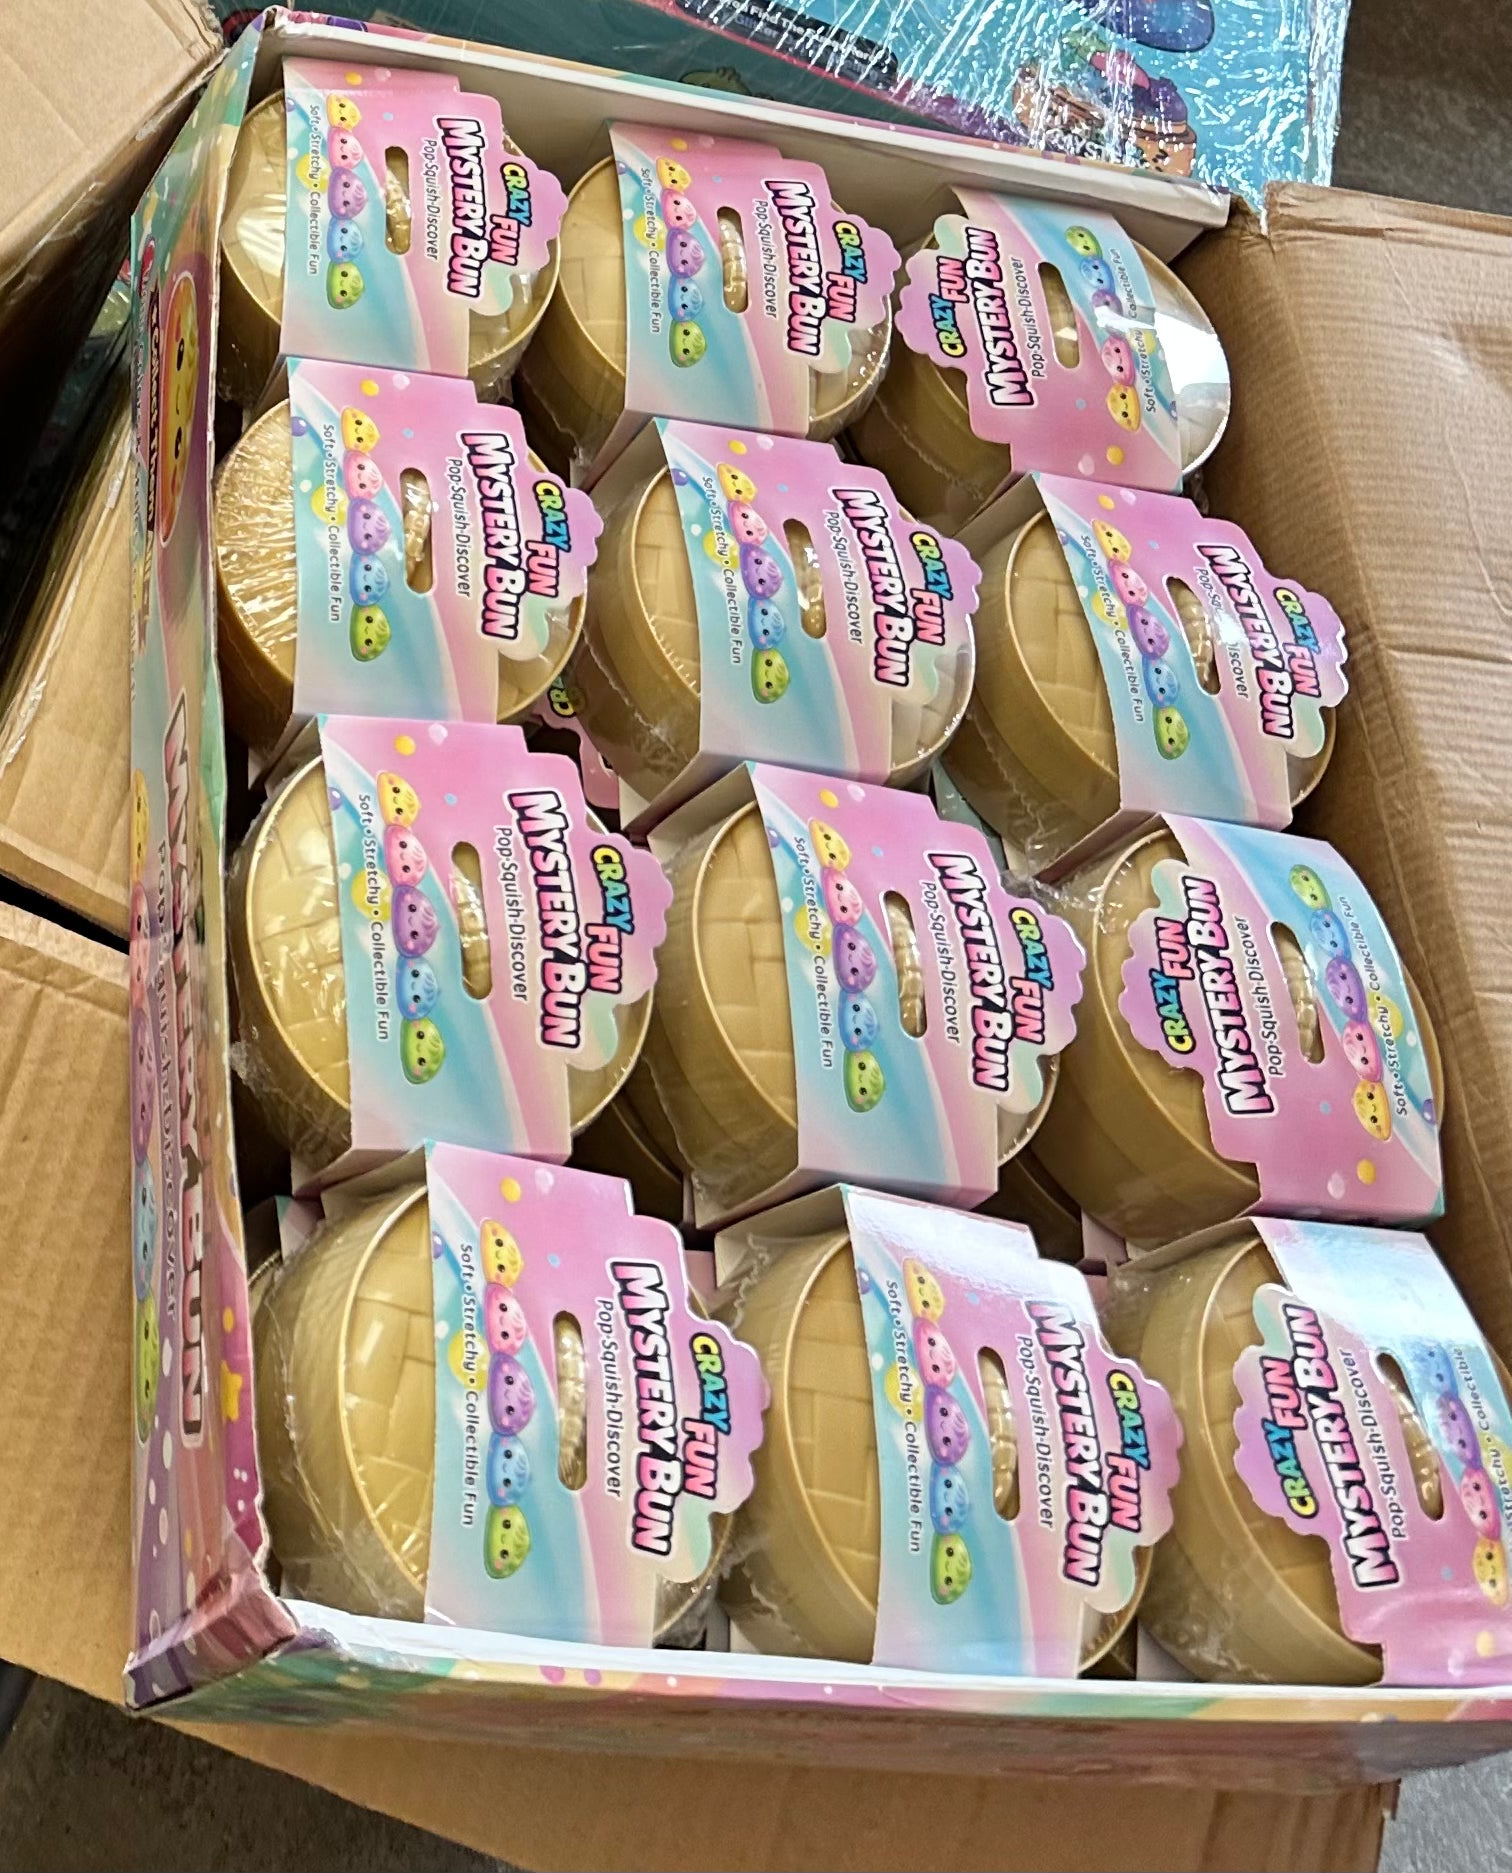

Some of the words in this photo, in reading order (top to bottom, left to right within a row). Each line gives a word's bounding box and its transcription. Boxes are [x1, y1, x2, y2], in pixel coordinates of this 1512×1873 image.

[310, 105, 319, 125] Soft
[310, 134, 321, 180] Stretchy
[438, 117, 486, 241] MYSTERY
[310, 192, 320, 249] Collectible
[500, 163, 532, 226] CRAZY
[308, 252, 317, 274] Fun
[447, 237, 487, 297] BUN
[489, 214, 521, 266] FUN
[765, 181, 823, 296] MYSTERY
[833, 221, 868, 283] CRAZY
[966, 227, 1002, 280] BUN
[827, 272, 856, 322] FUN
[938, 257, 969, 303] FUN
[789, 291, 825, 355] BUN
[929, 294, 967, 357] CRAZY
[974, 280, 1033, 406] MYSTERY
[323, 425, 333, 450] Soft
[326, 459, 338, 512] Stretchy
[461, 433, 521, 571] MYSTERY
[533, 480, 571, 552] CRAZY
[328, 525, 340, 592] Collectible
[526, 541, 559, 598] FUN
[833, 489, 908, 619] MYSTERY
[875, 614, 914, 687] BUN
[910, 532, 953, 600] CRAZY
[330, 598, 340, 621] Fun
[481, 565, 526, 640] BUN
[911, 589, 945, 645] FUN
[1274, 587, 1321, 654] CRAZY
[1197, 545, 1284, 672] MYSTERY
[1256, 667, 1294, 739] BUN
[1283, 643, 1321, 698] FUN
[359, 794, 371, 825] Soft
[363, 840, 379, 905] Stretchy
[508, 791, 580, 967] MYSTERY
[795, 837, 808, 866] Soft
[591, 844, 634, 935] CRAZY
[803, 879, 820, 939] Stretchy
[1182, 876, 1228, 952] BUN
[370, 921, 387, 1003] Collectible
[586, 923, 622, 994] FUN
[928, 853, 1005, 1016] MYSTERY
[972, 1006, 1013, 1092] BUN
[1009, 908, 1055, 991] CRAZY
[1154, 917, 1194, 980] FUN
[377, 1009, 388, 1040] Fun
[542, 959, 587, 1048] BUN
[814, 956, 830, 1034] Collectible
[1010, 977, 1046, 1045] FUN
[1149, 968, 1196, 1054] CRAZY
[165, 693, 197, 1159] MYSTERY
[181, 1177, 203, 1440] BUN
[821, 1039, 833, 1068] Fun
[1195, 953, 1274, 1116] MYSTERY
[461, 1243, 474, 1279] Soft
[886, 1280, 901, 1315] Soft
[463, 1296, 478, 1372] Stretchy
[612, 1262, 678, 1458] MYSTERY
[893, 1330, 912, 1404] Stretchy
[1283, 1303, 1336, 1394] BUN
[690, 1332, 732, 1435] CRAZY
[1025, 1299, 1103, 1490] MYSTERY
[1106, 1369, 1149, 1469] CRAZY
[1261, 1355, 1307, 1430] FUN
[465, 1389, 481, 1491] Collectible
[682, 1417, 718, 1499] FUN
[904, 1421, 922, 1517] Collectible
[1261, 1418, 1319, 1519] CRAZY
[461, 1498, 476, 1527] Fun
[632, 1451, 682, 1556] BUN
[1106, 1452, 1142, 1533] FUN
[1308, 1393, 1399, 1588] MYSTERY
[909, 1523, 921, 1553] Fun
[1063, 1482, 1108, 1586] BUN
